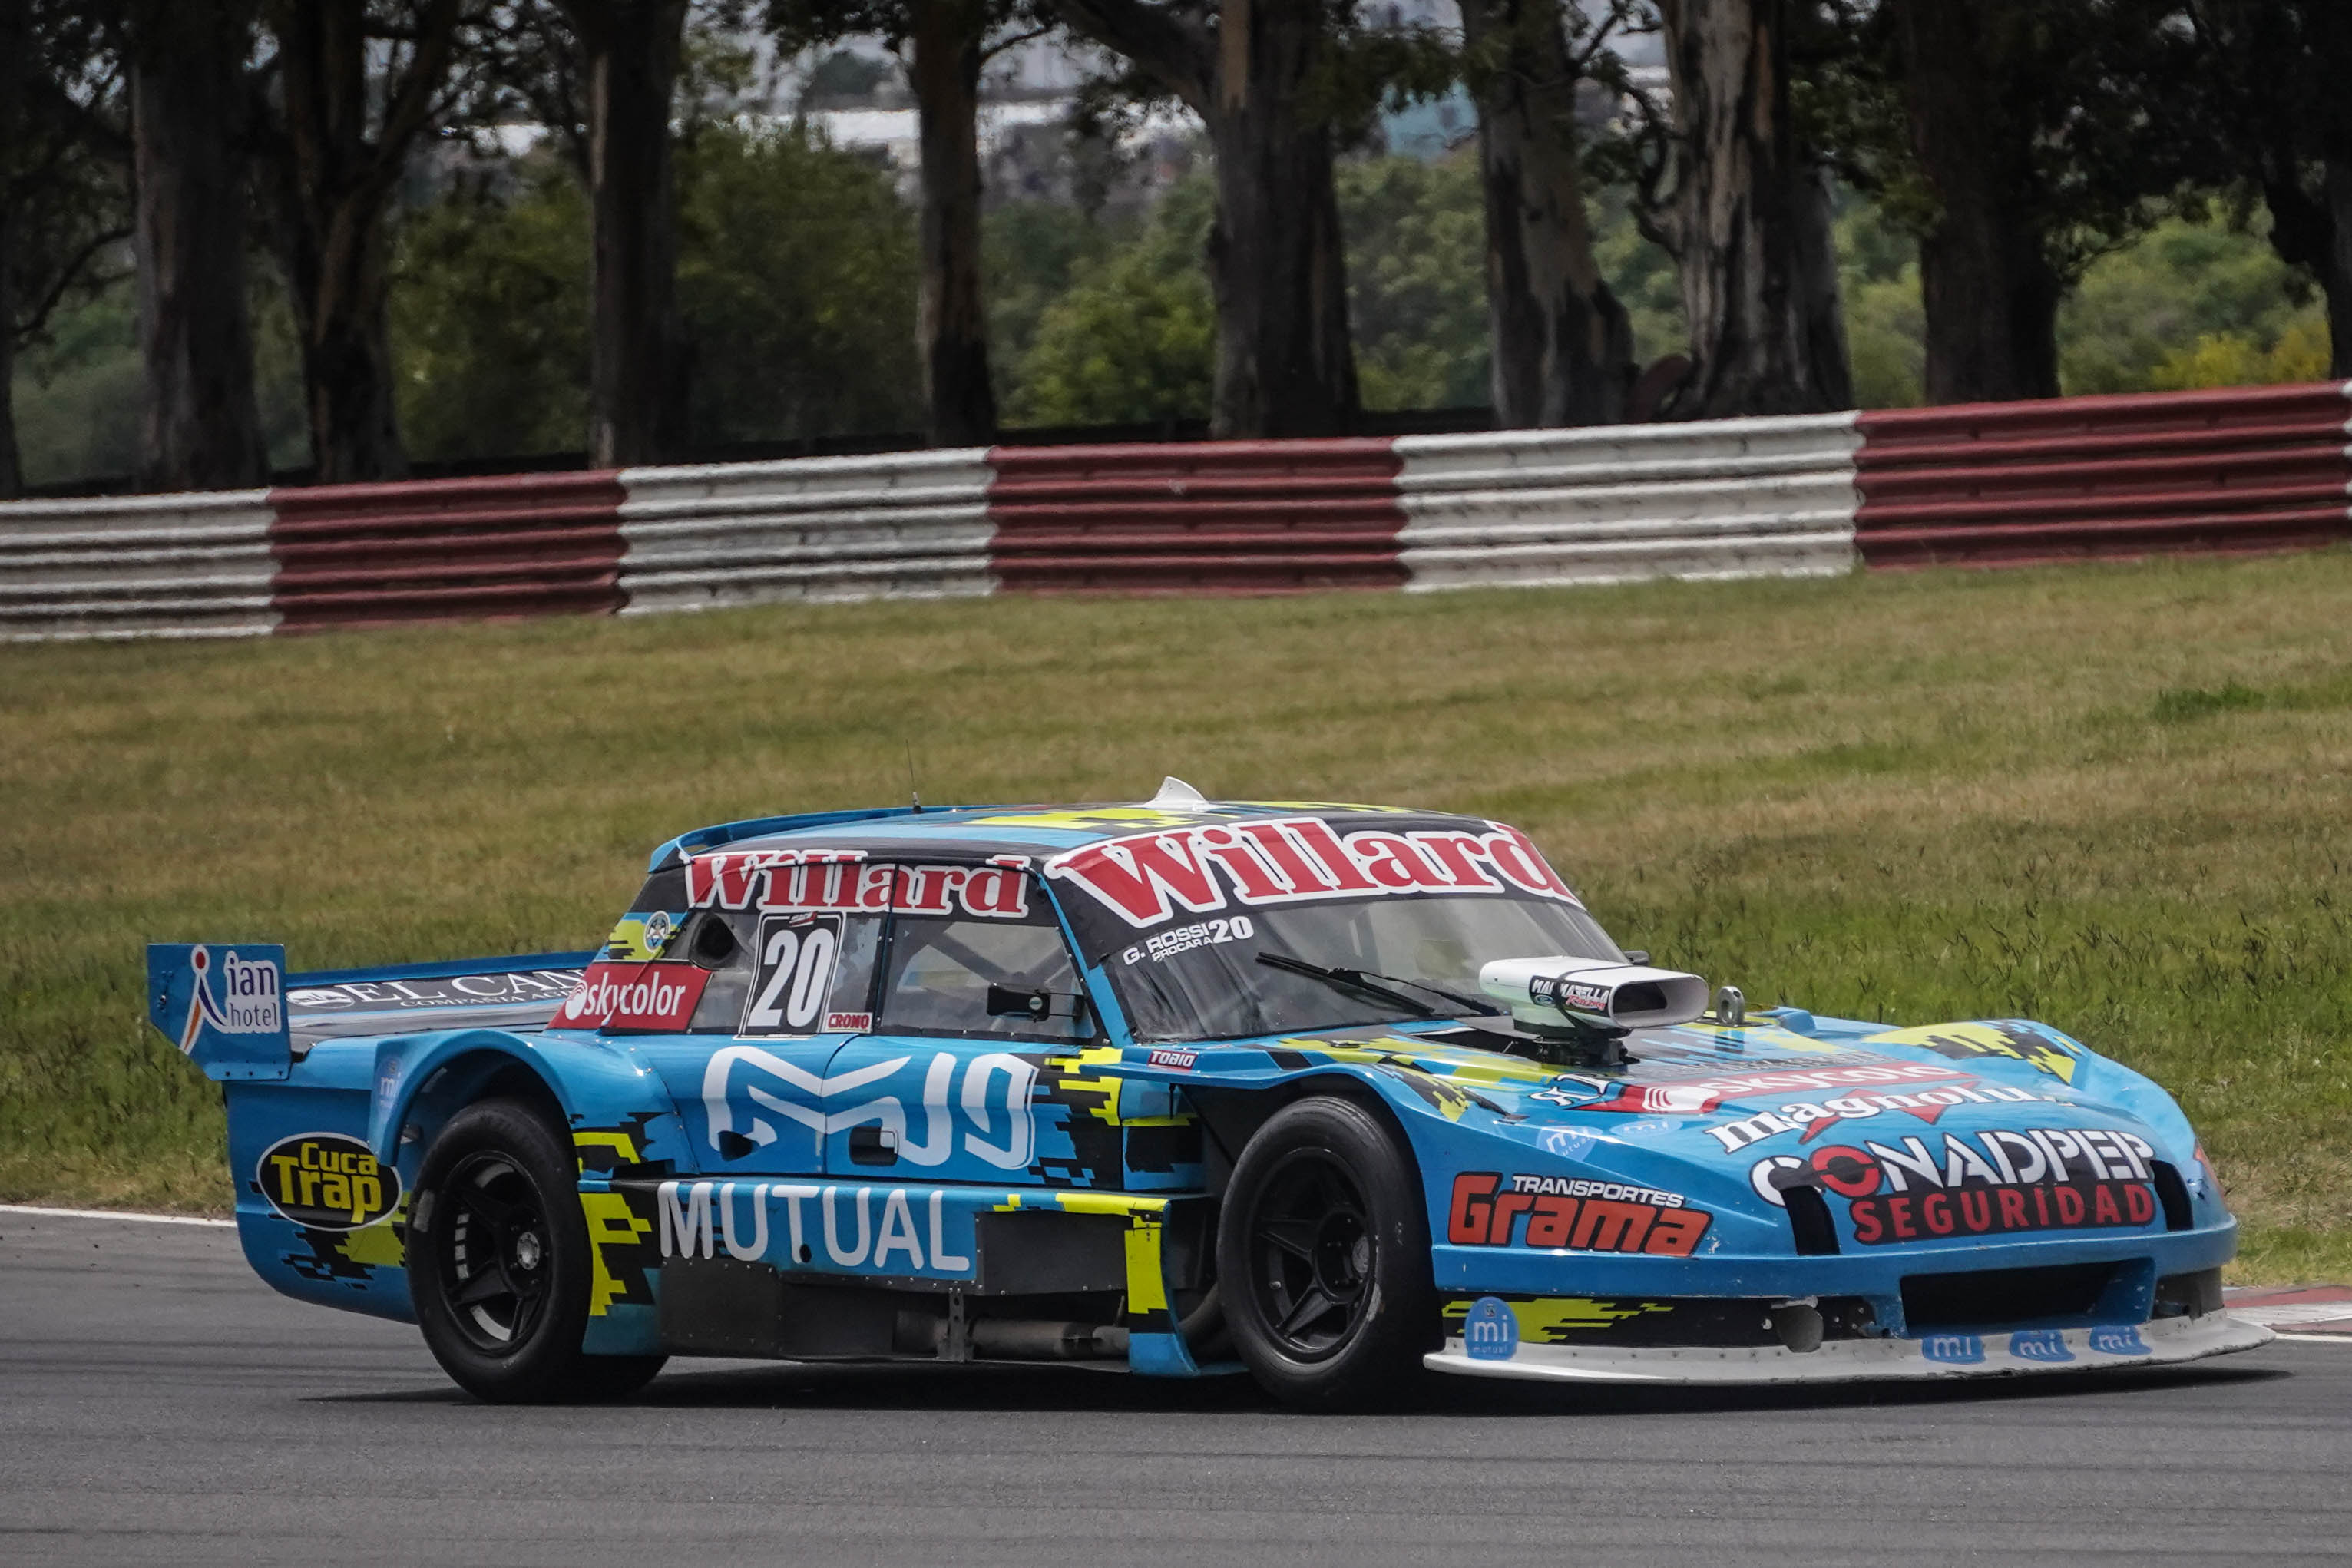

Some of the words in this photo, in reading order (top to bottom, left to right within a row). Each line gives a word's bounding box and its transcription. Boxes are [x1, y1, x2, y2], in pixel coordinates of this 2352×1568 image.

[683, 851, 1028, 916] Willard
[1046, 819, 1582, 926] Willard
[1123, 947, 1145, 965] G.
[1146, 923, 1209, 954] ROSSI
[1209, 916, 1254, 944] 20
[228, 957, 276, 996] ian
[334, 981, 445, 1003] EL
[747, 928, 835, 1027] 20
[230, 1002, 277, 1027] hotel
[583, 971, 686, 1027] skycolor
[828, 1014, 869, 1028] CRONO
[1151, 1050, 1196, 1067] TOBIO
[300, 1142, 379, 1176] Cuca
[270, 1155, 382, 1223] Trap
[1512, 1175, 1685, 1209] TRANSPORTES
[657, 1182, 970, 1271] MUTUAL
[1449, 1173, 1712, 1258] Grama
[1852, 1183, 2154, 1241] SEGURIDAD
[1474, 1314, 1509, 1342] mi
[2019, 1333, 2059, 1357] mi
